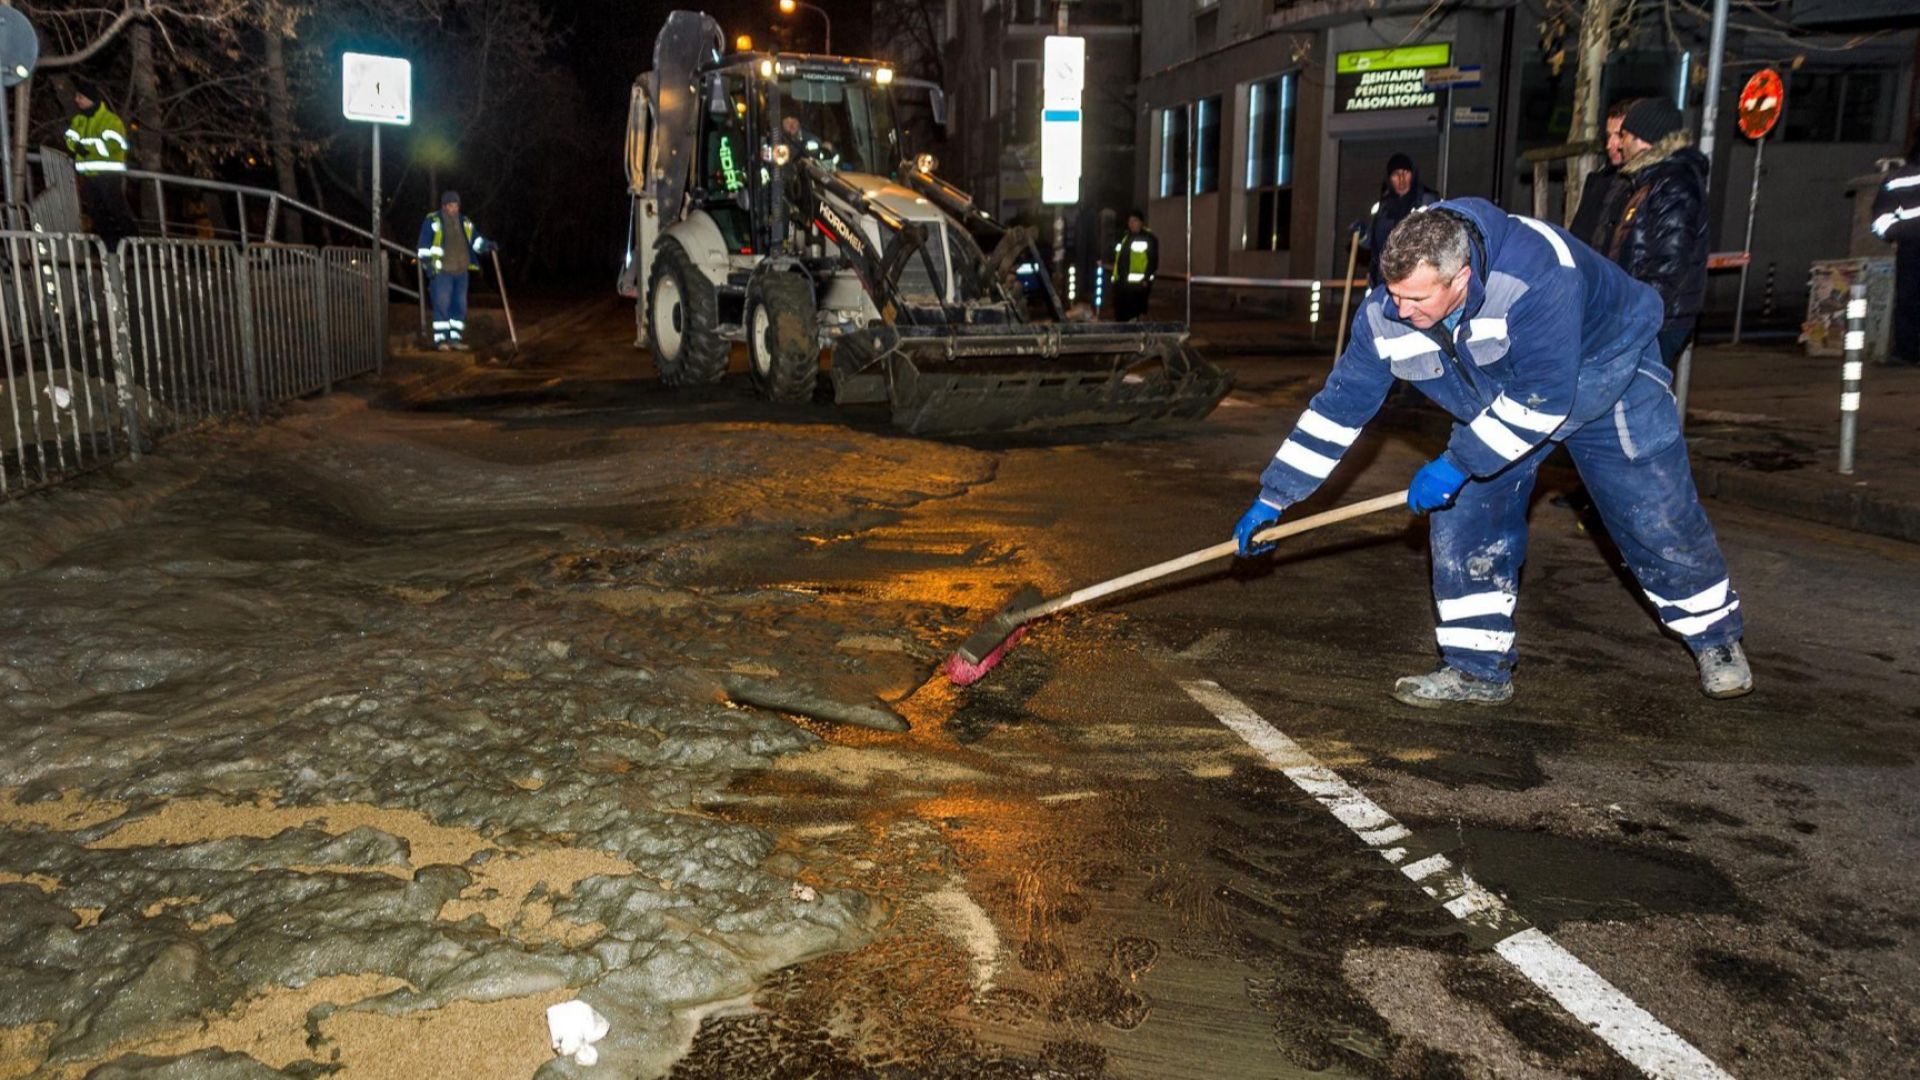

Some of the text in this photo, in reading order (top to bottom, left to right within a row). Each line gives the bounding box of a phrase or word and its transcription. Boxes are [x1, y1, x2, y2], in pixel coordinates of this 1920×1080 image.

[1361, 68, 1425, 86] ДЕНТАЛНА
[1355, 80, 1424, 98] РЕНТГЕНОВ
[1346, 92, 1435, 111] ЛАБОРАТОРИЯ
